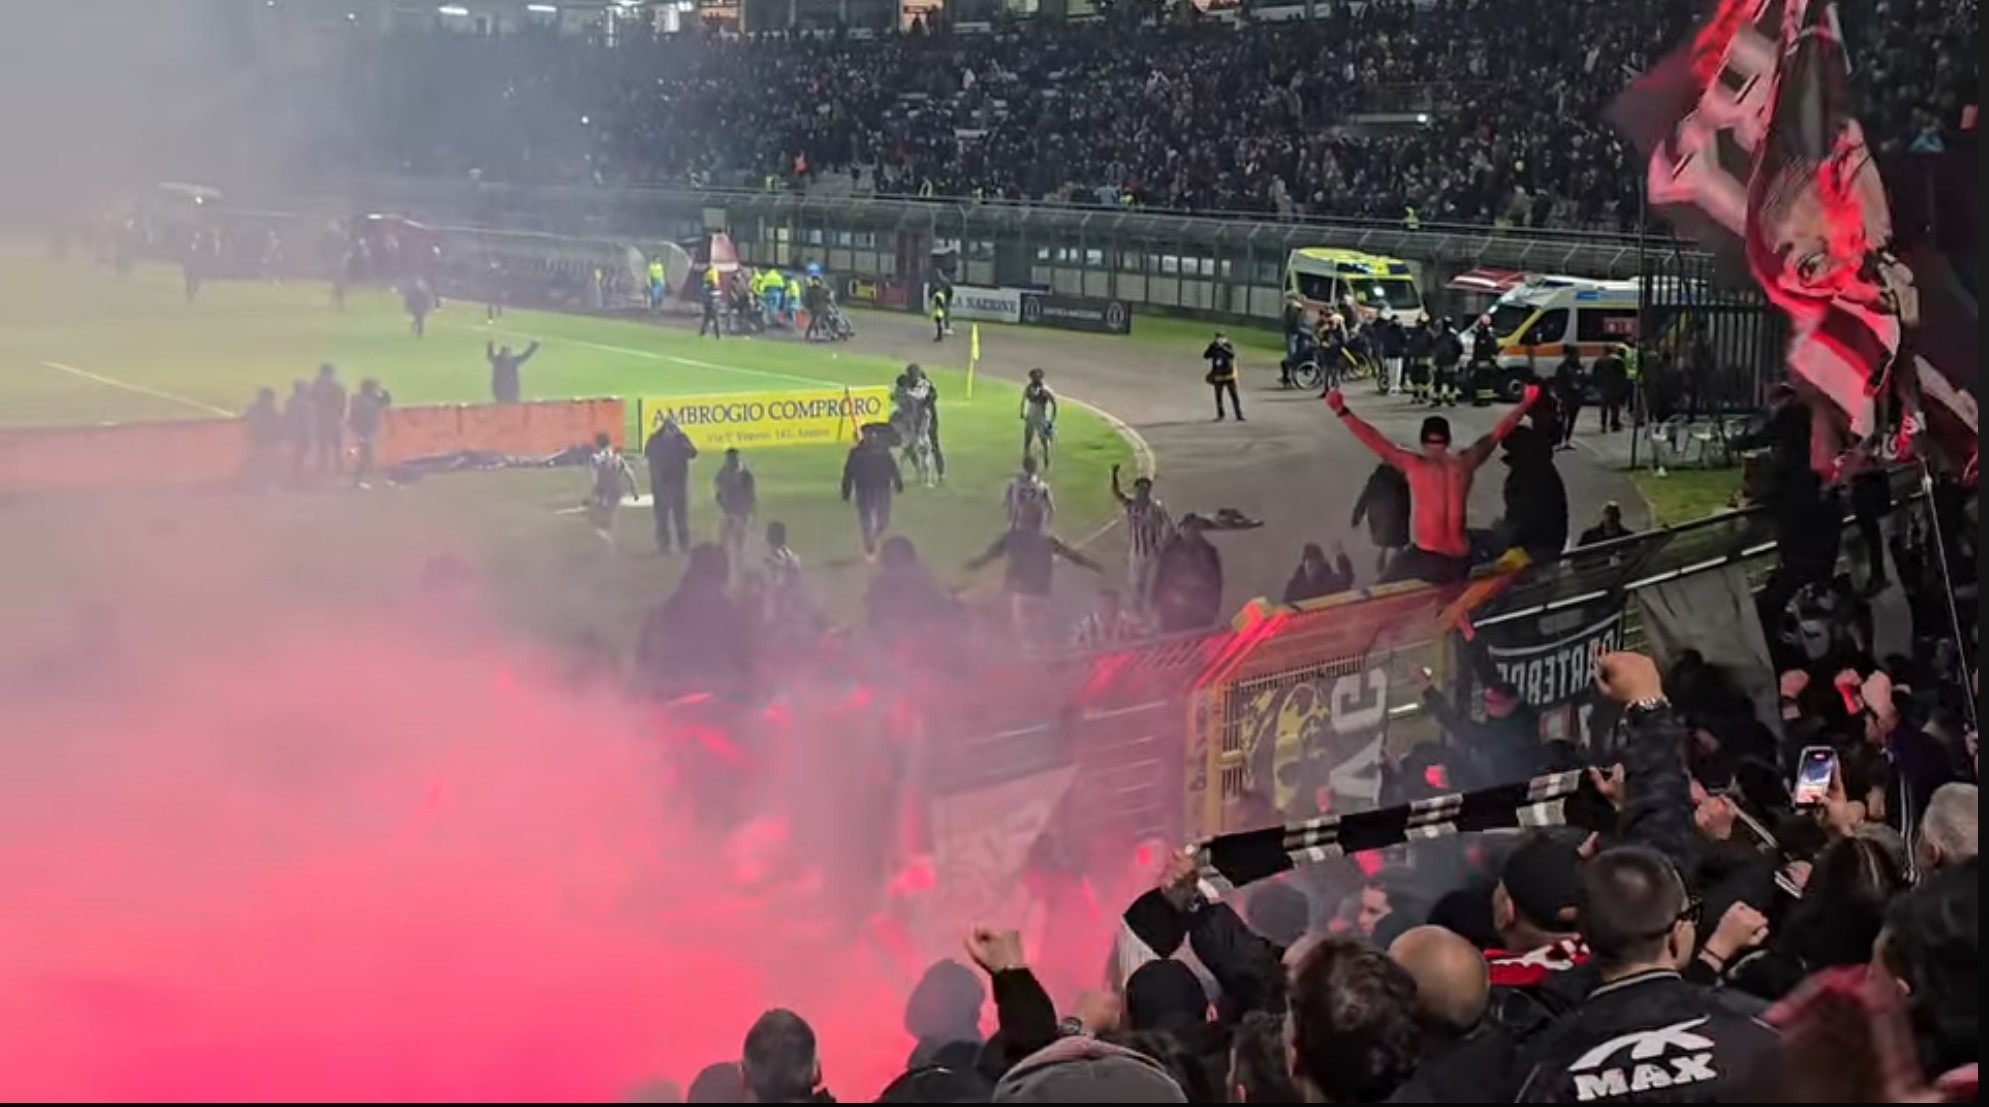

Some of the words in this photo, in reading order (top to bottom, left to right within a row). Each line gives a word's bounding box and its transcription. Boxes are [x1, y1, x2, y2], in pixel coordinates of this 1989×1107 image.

[966, 296, 1017, 314] NAZIONE
[652, 401, 765, 428] AMBROGIO
[1574, 1053, 1717, 1101] MAX
